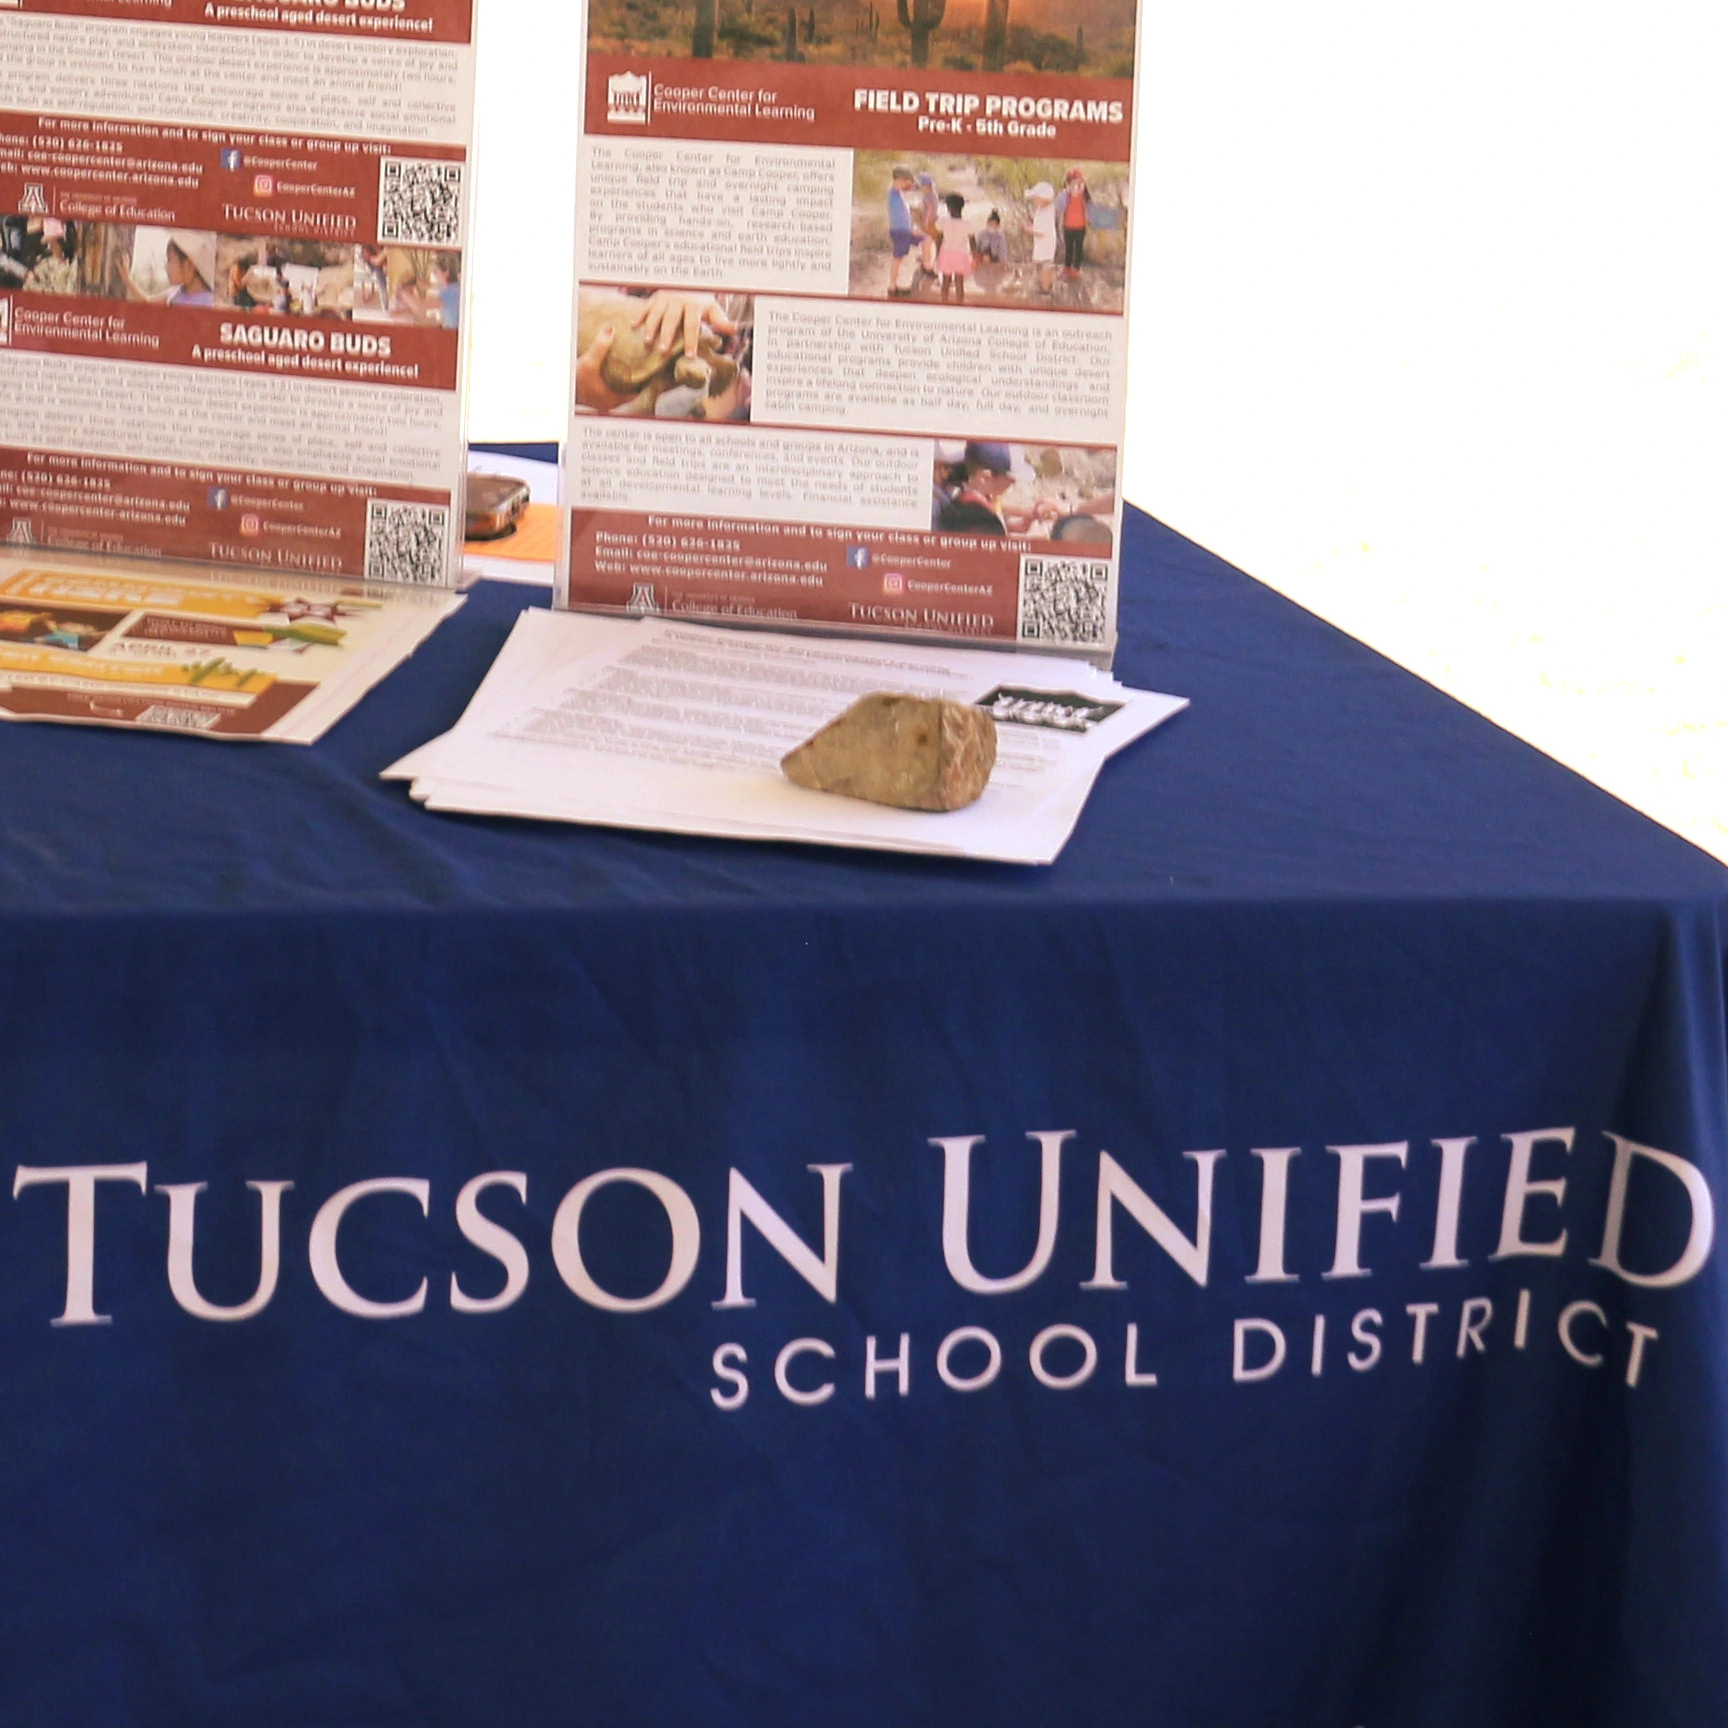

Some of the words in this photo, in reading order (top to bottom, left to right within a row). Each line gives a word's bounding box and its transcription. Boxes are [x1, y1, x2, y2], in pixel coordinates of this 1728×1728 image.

[205, 2, 214, 17] A
[217, 5, 278, 22] preschool
[281, 8, 314, 24] aged
[316, 10, 357, 27] desert
[359, 13, 433, 34] experience!
[653, 83, 704, 101] Cooper
[708, 87, 754, 102] Center
[758, 89, 777, 103] for
[853, 88, 920, 113] FIELD
[925, 92, 980, 116] TRIP
[986, 94, 1124, 123] PROGRAMS
[653, 98, 752, 117] Environmental
[755, 104, 816, 122] Learning
[39, 117, 57, 129] For
[60, 119, 89, 132] more
[93, 122, 159, 138] information
[162, 127, 183, 139] and
[187, 128, 198, 139] to
[202, 130, 226, 144] sign
[229, 132, 255, 146] your
[259, 133, 287, 148] class
[291, 138, 302, 148] or
[307, 139, 340, 153] group
[344, 142, 359, 154] up
[363, 143, 391, 155] visit:
[918, 115, 962, 134] Pre-K
[975, 118, 1004, 135] 5th
[1007, 120, 1056, 138] Grade
[59, 200, 102, 218] College
[106, 202, 117, 215] of
[120, 204, 176, 222] Education
[222, 204, 286, 223] TUCSON
[291, 209, 357, 228] UNIFIED
[14, 306, 60, 324] Cooper
[63, 310, 105, 327] Center
[109, 315, 125, 329] for
[14, 320, 103, 341] Environmental
[106, 330, 160, 349] Learning
[220, 322, 325, 352] SAGUARO
[330, 331, 391, 358] BUDS
[192, 344, 202, 359] A
[204, 346, 265, 365] preschool
[268, 352, 299, 370] aged
[302, 355, 342, 372] desert
[345, 359, 419, 379] experience!
[28, 452, 44, 465] For
[49, 455, 78, 468] more
[81, 457, 147, 473] information
[150, 463, 171, 476] and
[175, 465, 186, 477] to
[190, 467, 214, 482] sign
[216, 471, 242, 485] your
[246, 472, 275, 486] class
[278, 477, 289, 487] or
[294, 479, 327, 493] group
[330, 482, 344, 495] up
[348, 483, 377, 496] visit:
[596, 531, 637, 545] Phone:
[648, 515, 667, 526] For
[672, 518, 704, 530] more
[707, 518, 779, 536] information
[783, 524, 806, 537] and
[810, 525, 822, 537] to
[827, 527, 852, 541] sign
[856, 529, 884, 543] your
[888, 531, 919, 545] class
[923, 535, 936, 545] or
[941, 536, 977, 551] group
[981, 540, 996, 552] up
[1000, 539, 1032, 553] visit:
[209, 542, 272, 562] TUCSON
[278, 548, 343, 569] UNIFIED
[595, 546, 633, 559] Email:
[595, 561, 626, 573] Web:
[737, 603, 797, 620] Education
[850, 602, 917, 621] TUCSON
[924, 607, 994, 628] UNIFIED
[10, 1159, 853, 1328] TUCSON
[926, 1125, 1717, 1294] UNIFIED
[707, 1320, 1160, 1410] SCHOOL
[1230, 1286, 1661, 1390] DISTRICT
